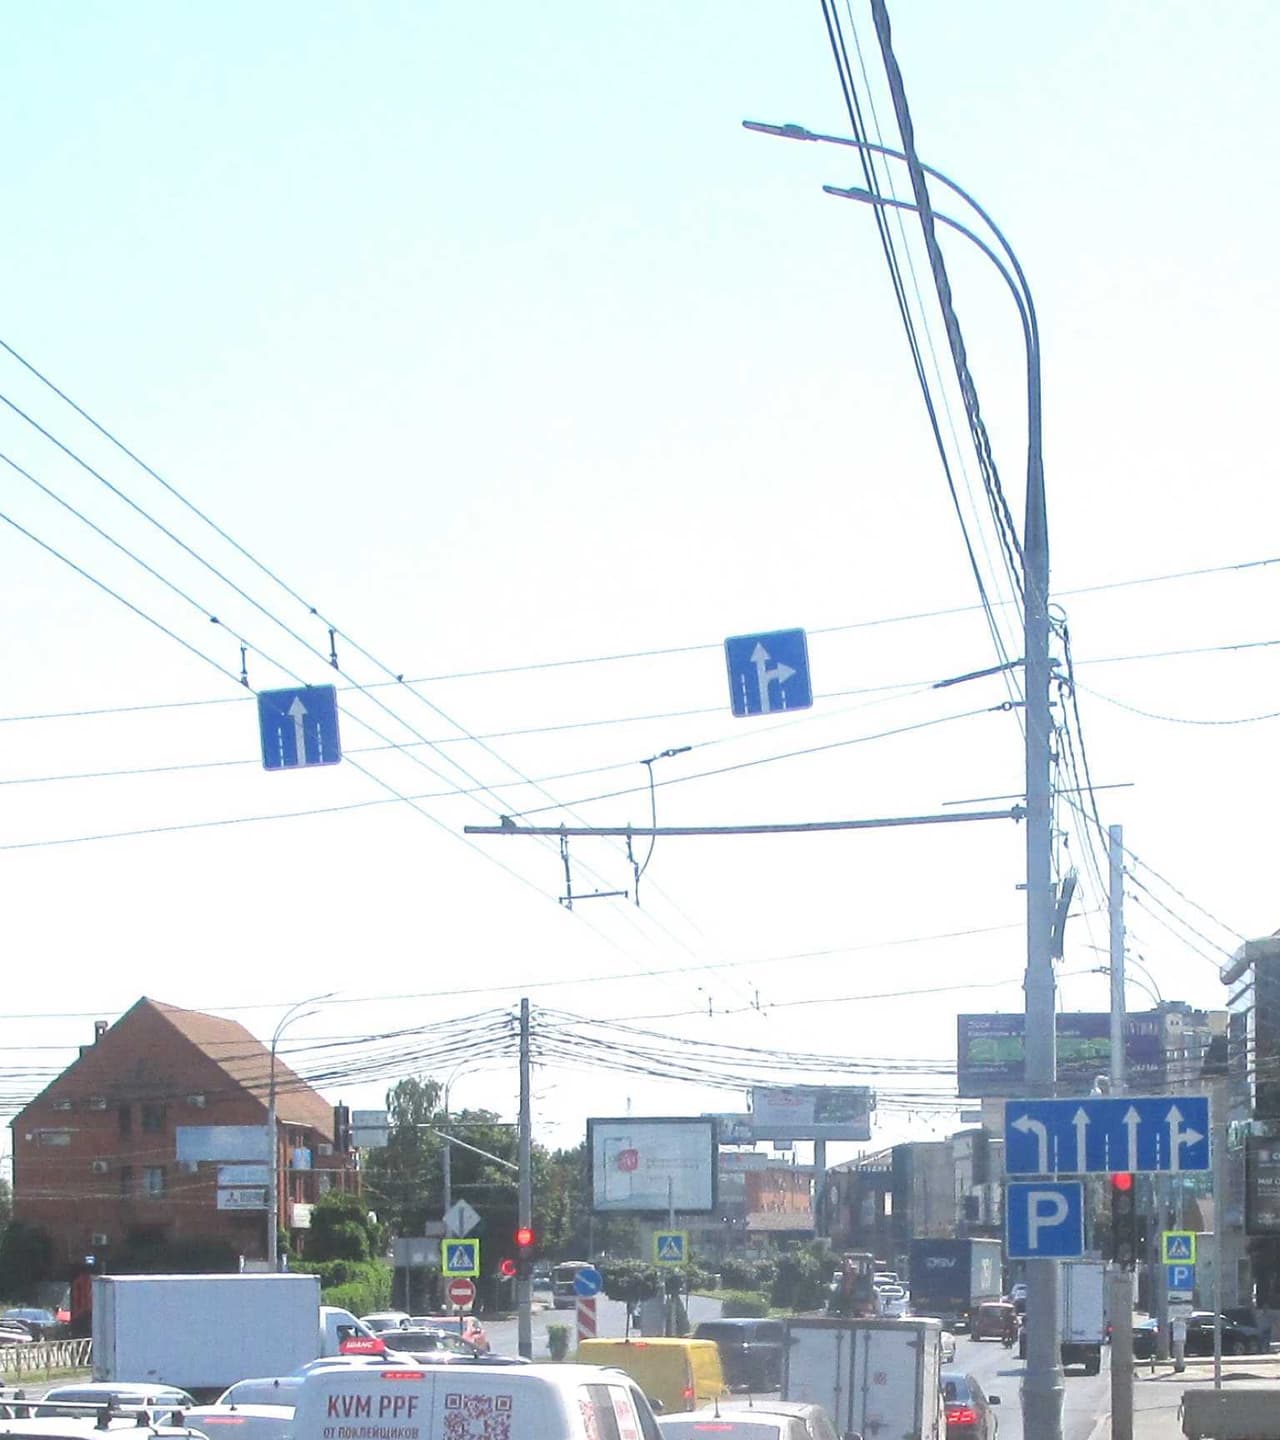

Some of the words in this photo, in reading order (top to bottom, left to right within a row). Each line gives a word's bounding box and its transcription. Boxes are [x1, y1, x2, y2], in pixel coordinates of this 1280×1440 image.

[1027, 1190, 1070, 1249] P
[327, 1394, 372, 1419] KVM
[378, 1394, 420, 1419] PPF
